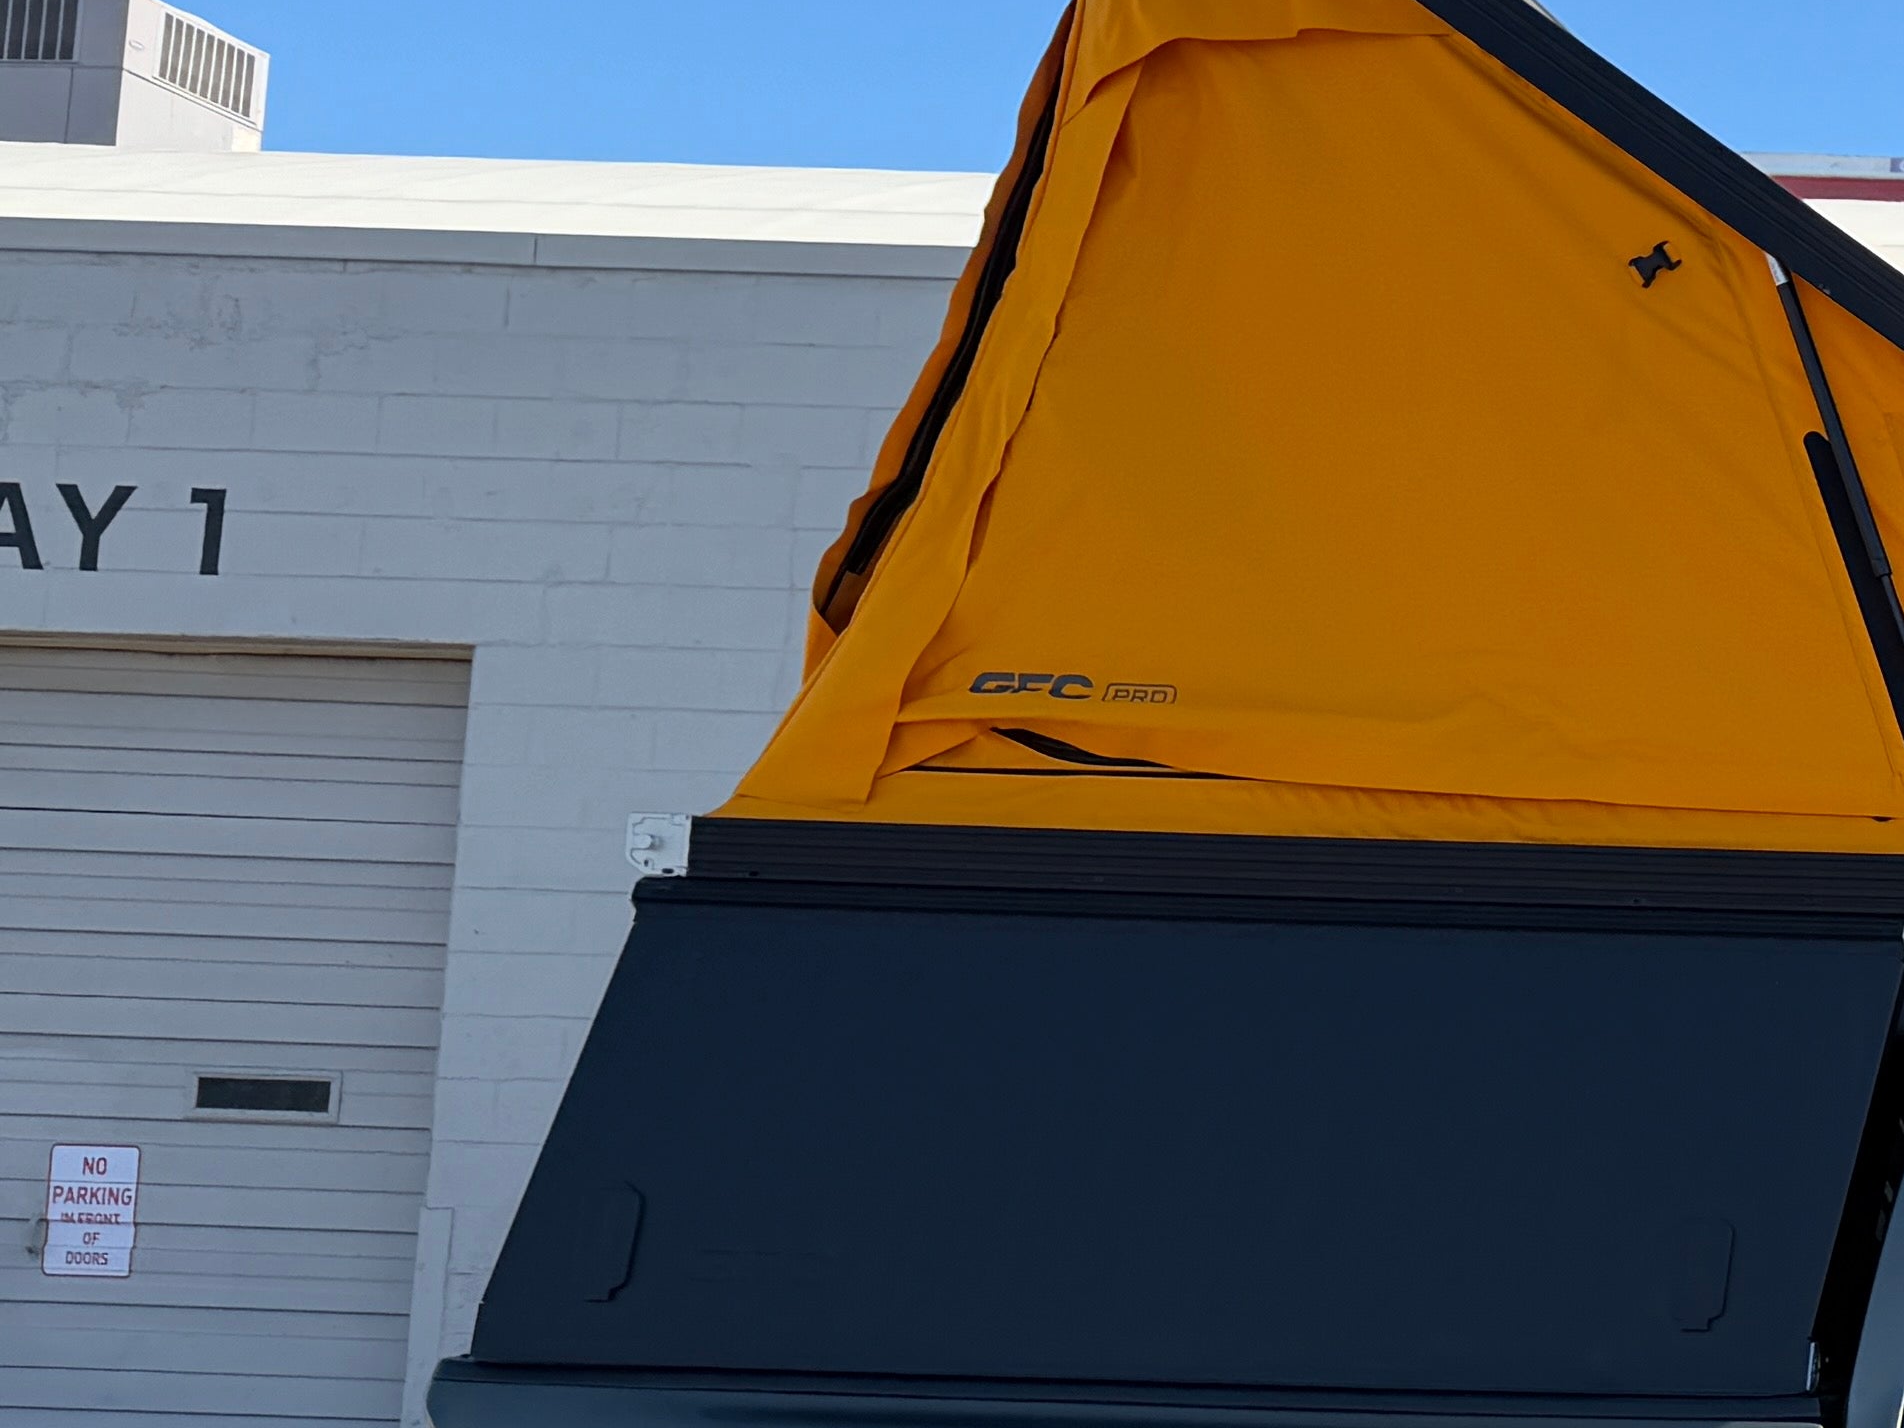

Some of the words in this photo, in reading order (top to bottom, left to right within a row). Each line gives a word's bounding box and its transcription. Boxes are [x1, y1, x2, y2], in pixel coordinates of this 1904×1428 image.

[190, 487, 227, 576] 1
[968, 671, 1094, 701] GFC
[1112, 688, 1168, 704] PRO
[82, 1157, 107, 1176] NO
[52, 1185, 133, 1206] PARKING
[83, 1232, 100, 1246] OF
[65, 1251, 108, 1266] DOORS
